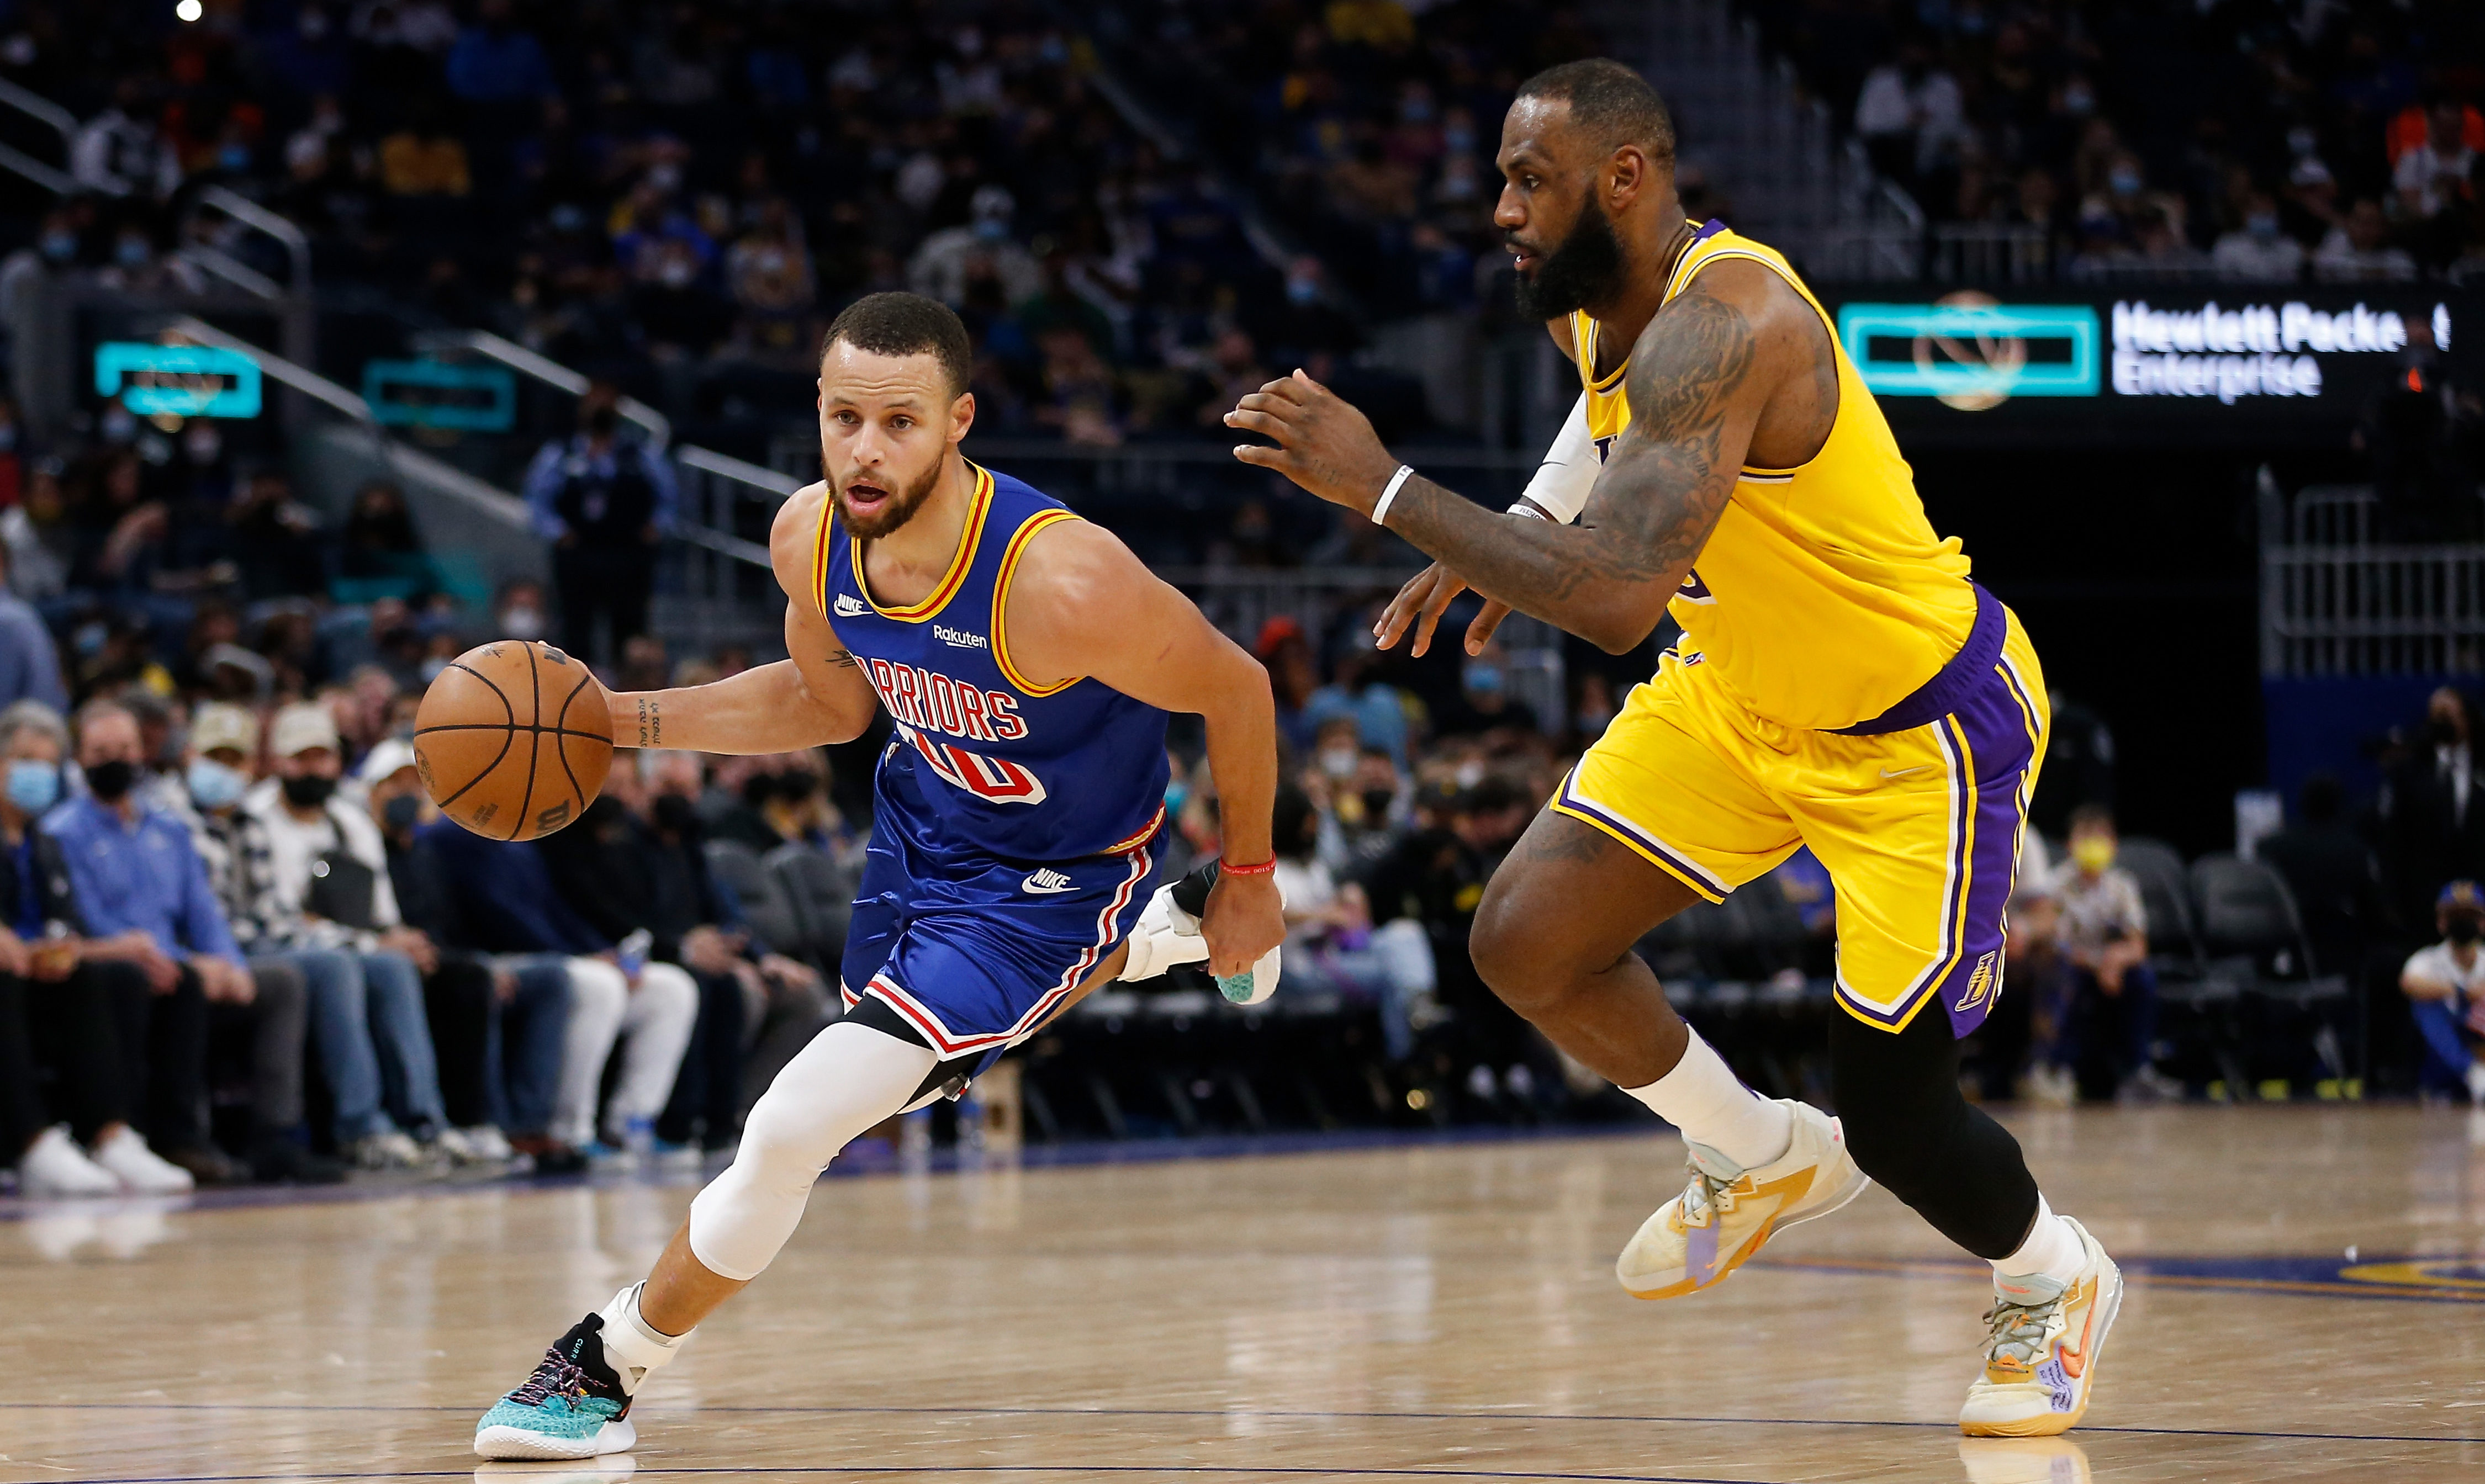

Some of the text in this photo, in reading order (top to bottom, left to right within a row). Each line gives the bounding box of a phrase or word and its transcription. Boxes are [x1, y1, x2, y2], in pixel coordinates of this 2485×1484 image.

[2112, 301, 2451, 352] Hewlett Packa
[2113, 353, 2322, 405] Enterprise
[837, 593, 864, 613] NIKE
[933, 624, 987, 649] Rakuten
[1031, 867, 1071, 889] NIKE
